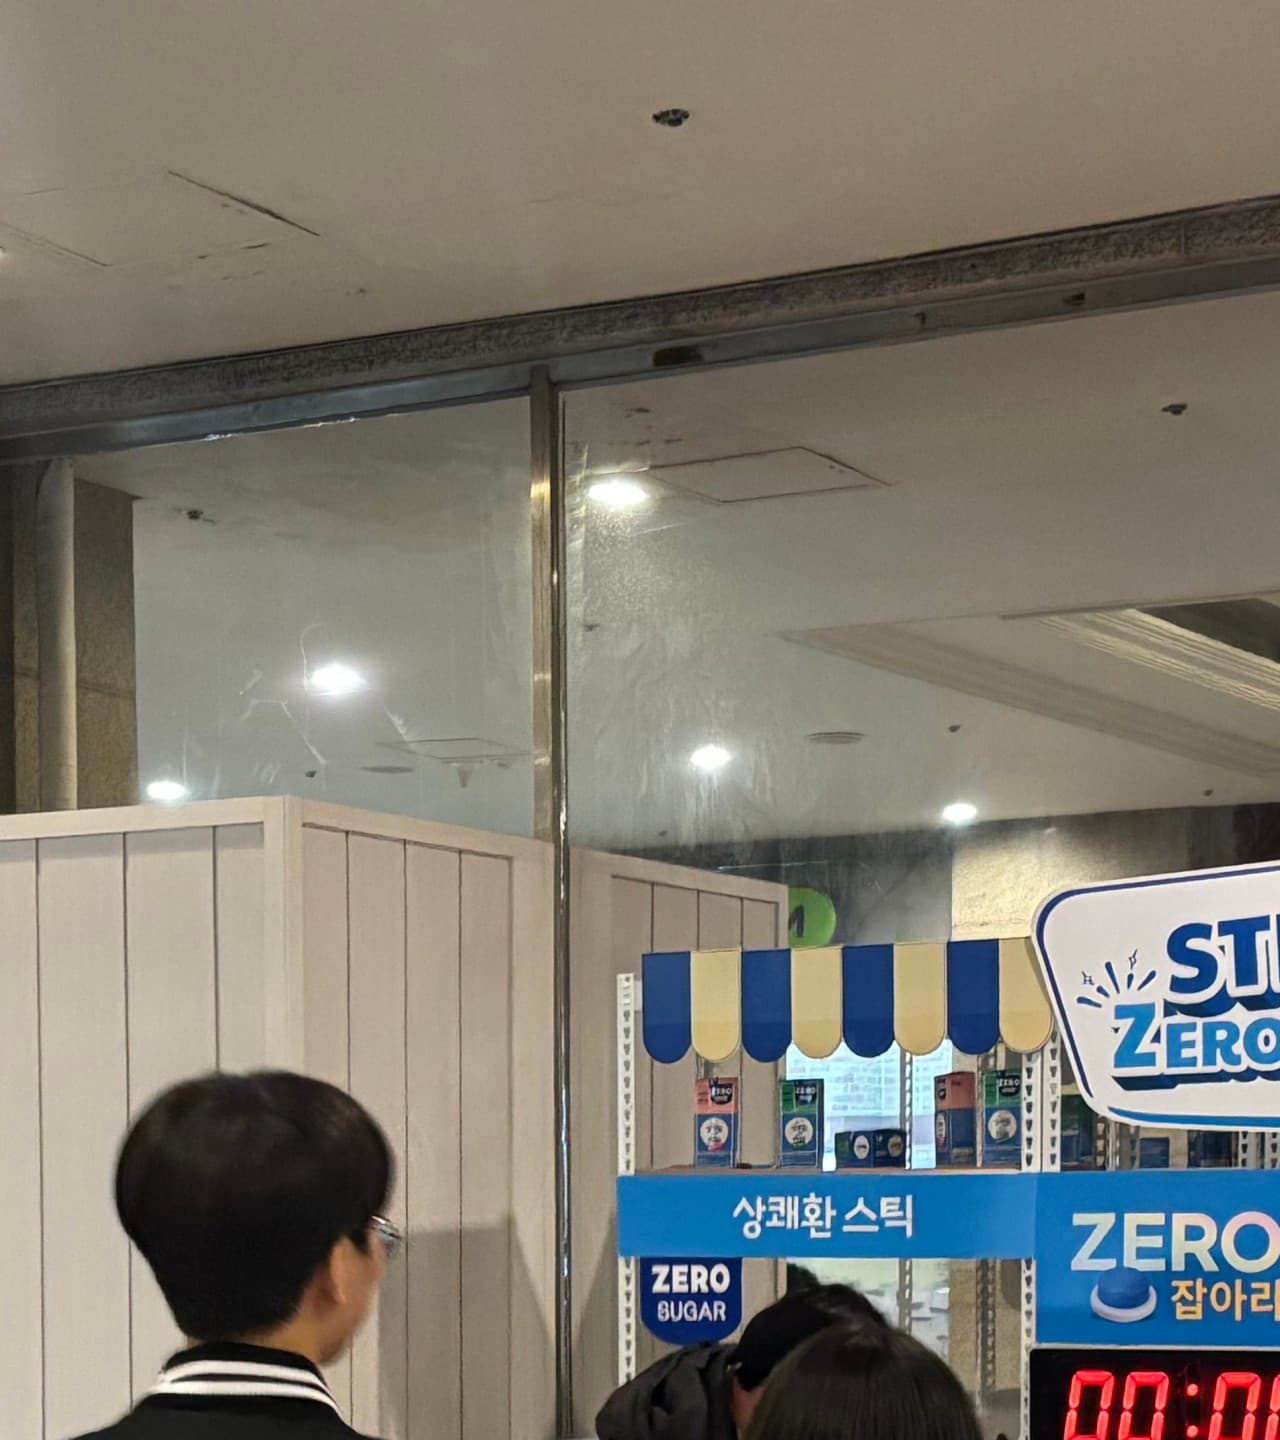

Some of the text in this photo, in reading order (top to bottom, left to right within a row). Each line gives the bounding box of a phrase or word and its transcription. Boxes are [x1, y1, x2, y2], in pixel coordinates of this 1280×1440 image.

[733, 1192, 913, 1239] 상쾌환 스틱
[651, 1264, 731, 1294] ZERO
[657, 1301, 727, 1322] SUGAR
